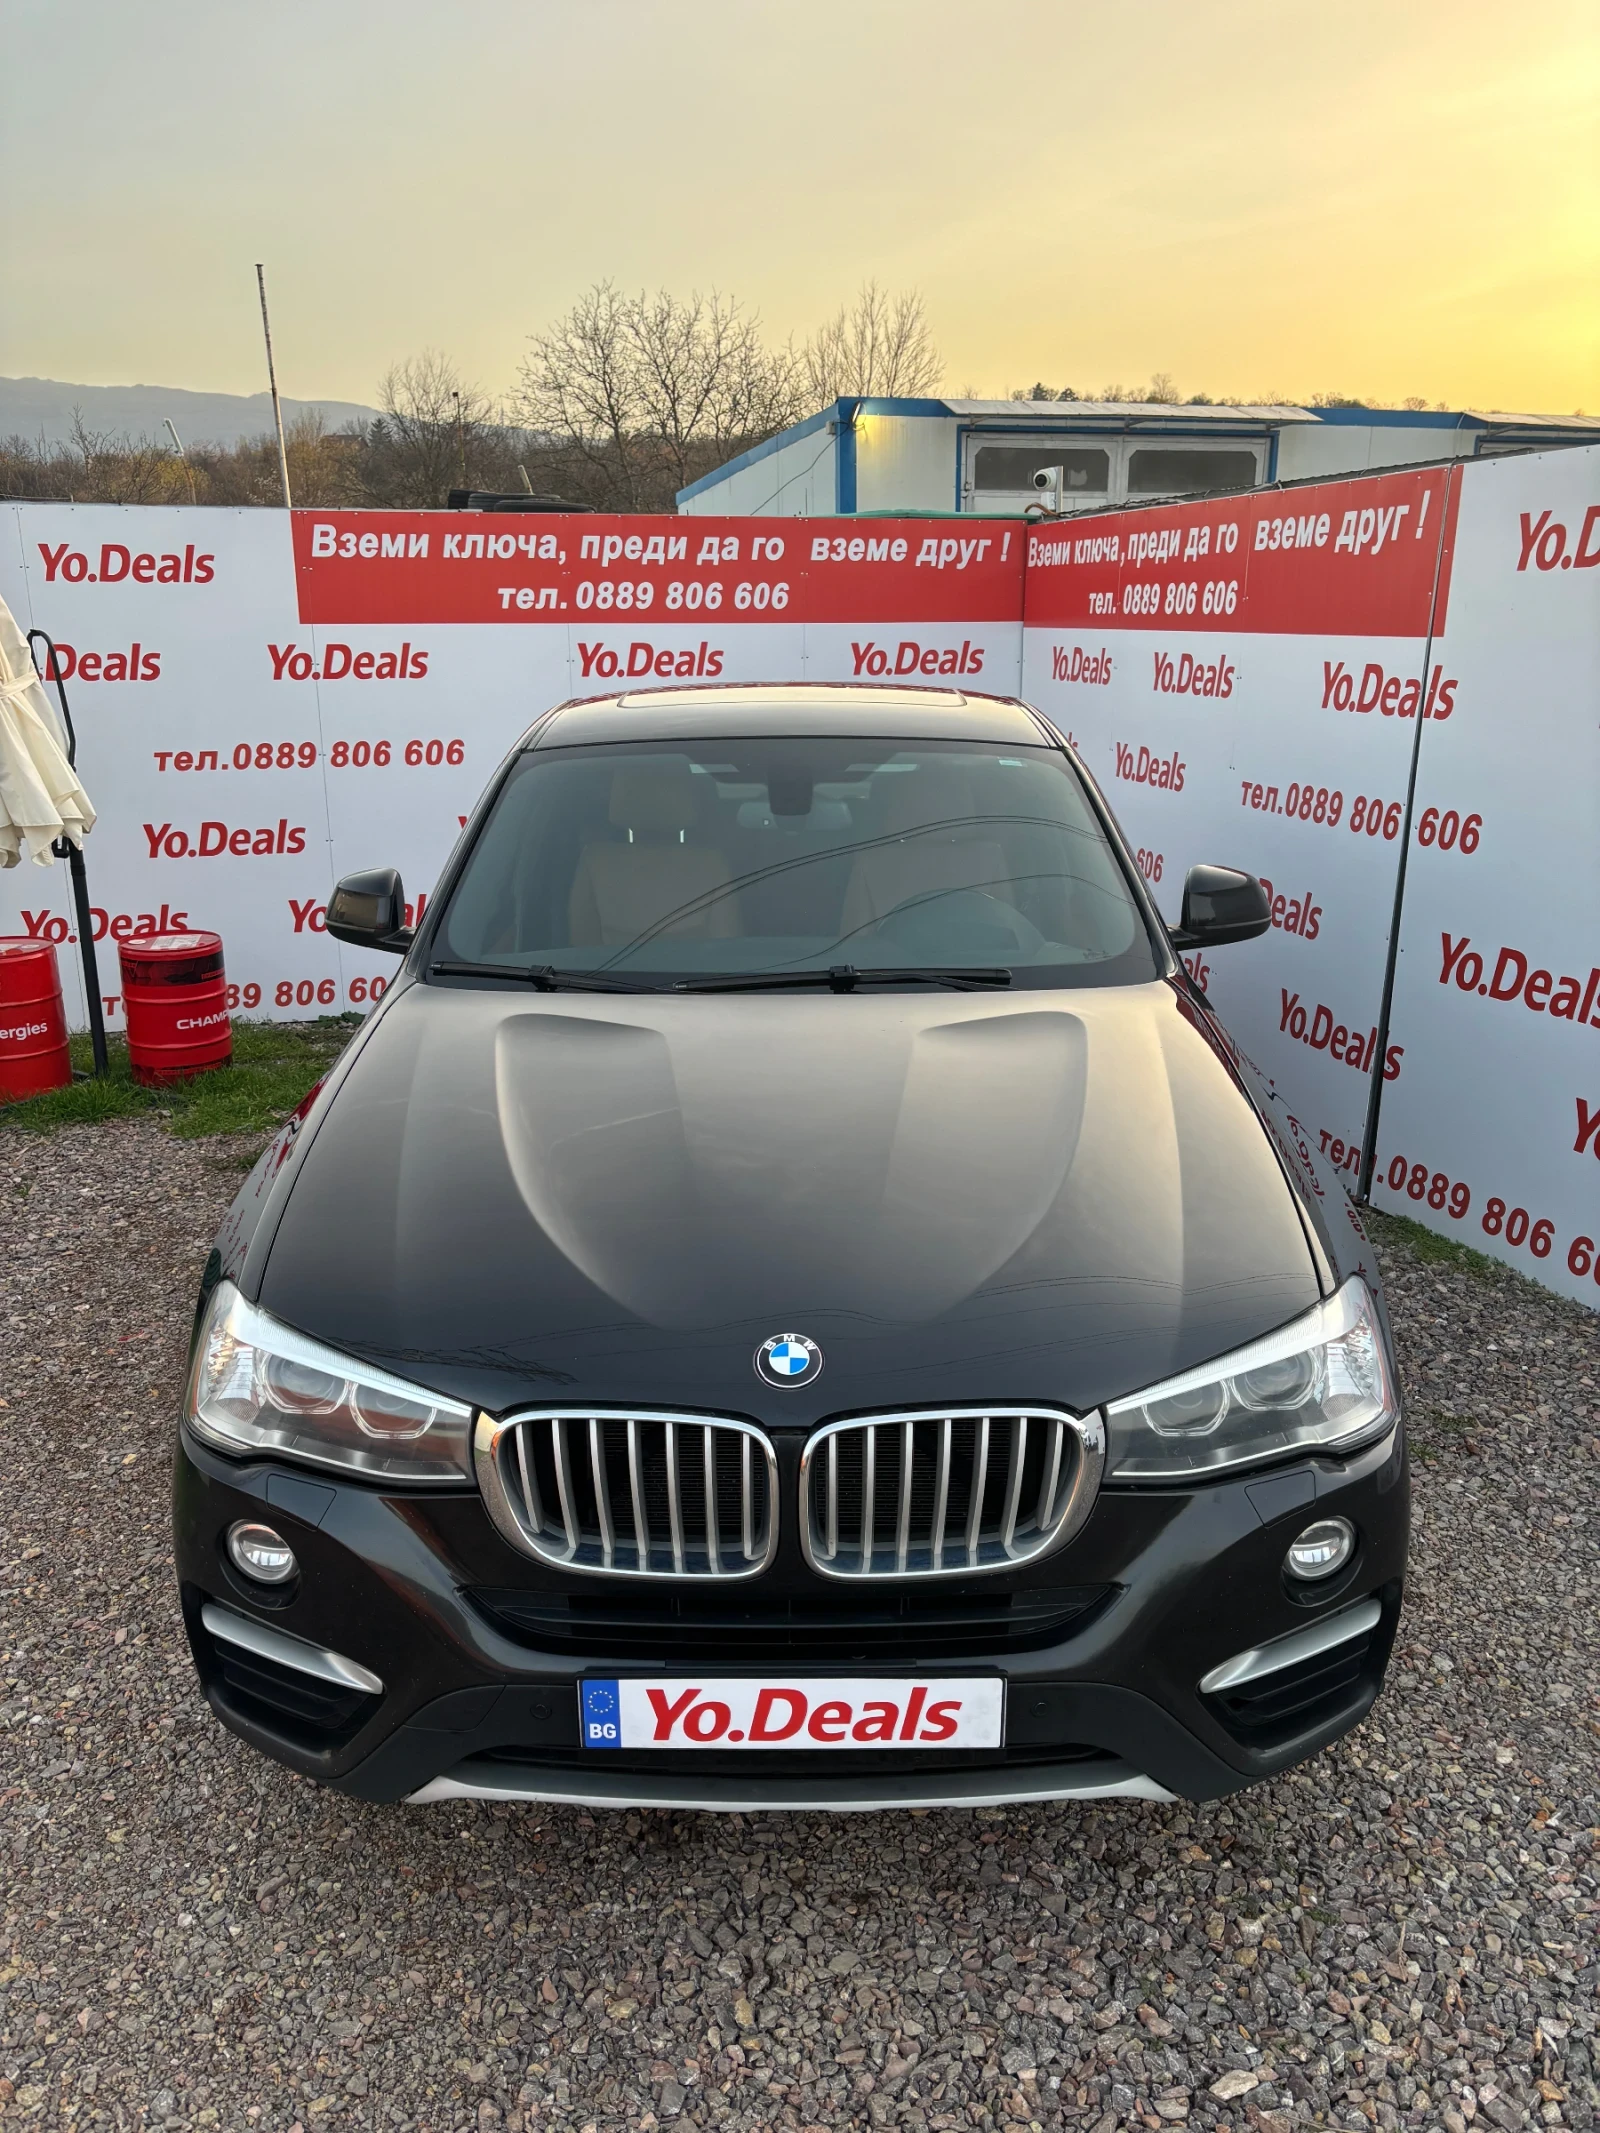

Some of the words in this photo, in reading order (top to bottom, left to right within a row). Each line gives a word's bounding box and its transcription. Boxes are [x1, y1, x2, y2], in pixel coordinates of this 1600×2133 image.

[311, 524, 429, 558] Вземи
[442, 532, 566, 565] ключа,
[580, 535, 688, 567] преди
[697, 536, 739, 566] да
[751, 537, 785, 561] го
[811, 537, 908, 562] вземе
[915, 538, 991, 569] друг
[1000, 532, 1011, 562] !
[1027, 537, 1070, 568] Вземи
[1074, 532, 1125, 567] ключа,
[1127, 526, 1181, 568] преди
[1184, 527, 1209, 557] да
[1215, 522, 1239, 554] го
[1254, 513, 1330, 551] вземе
[1334, 505, 1410, 555] друг
[1415, 490, 1431, 539] !
[38, 543, 215, 584] Yo.Deals
[498, 588, 568, 610] тел.
[575, 581, 655, 610] 0889
[665, 581, 723, 610] 806
[734, 582, 790, 610] 606
[1088, 591, 1116, 615] тел.
[1122, 583, 1160, 615] 0889
[1164, 582, 1197, 615] 806
[1202, 580, 1238, 615] 606
[267, 643, 429, 680] Yo.Deals
[577, 642, 724, 678] Yo.Deals
[850, 640, 985, 676] Yo.Deals
[1051, 646, 1113, 686] Yo.Deals
[1152, 651, 1235, 699] Yo.Deals
[1321, 661, 1459, 721] Yo.Deals
[153, 743, 317, 771] тел.0889
[330, 741, 392, 768] 806
[404, 739, 466, 766] 606
[1115, 741, 1187, 793] Yo.Deals
[1241, 780, 1343, 827] тел.0889
[1350, 795, 1402, 841] 806
[1417, 806, 1483, 855] 606
[143, 818, 306, 859] Yo.Deals
[20, 904, 189, 944] Yo.Deals
[274, 979, 336, 1007] 806
[349, 976, 387, 1003] 60
[1279, 987, 1405, 1081] Yo.Deals
[1481, 1197, 1556, 1258] 806
[764, 1334, 818, 1351] BMW
[589, 1723, 617, 1740] BG
[645, 1686, 963, 1743] Yo.Deals
